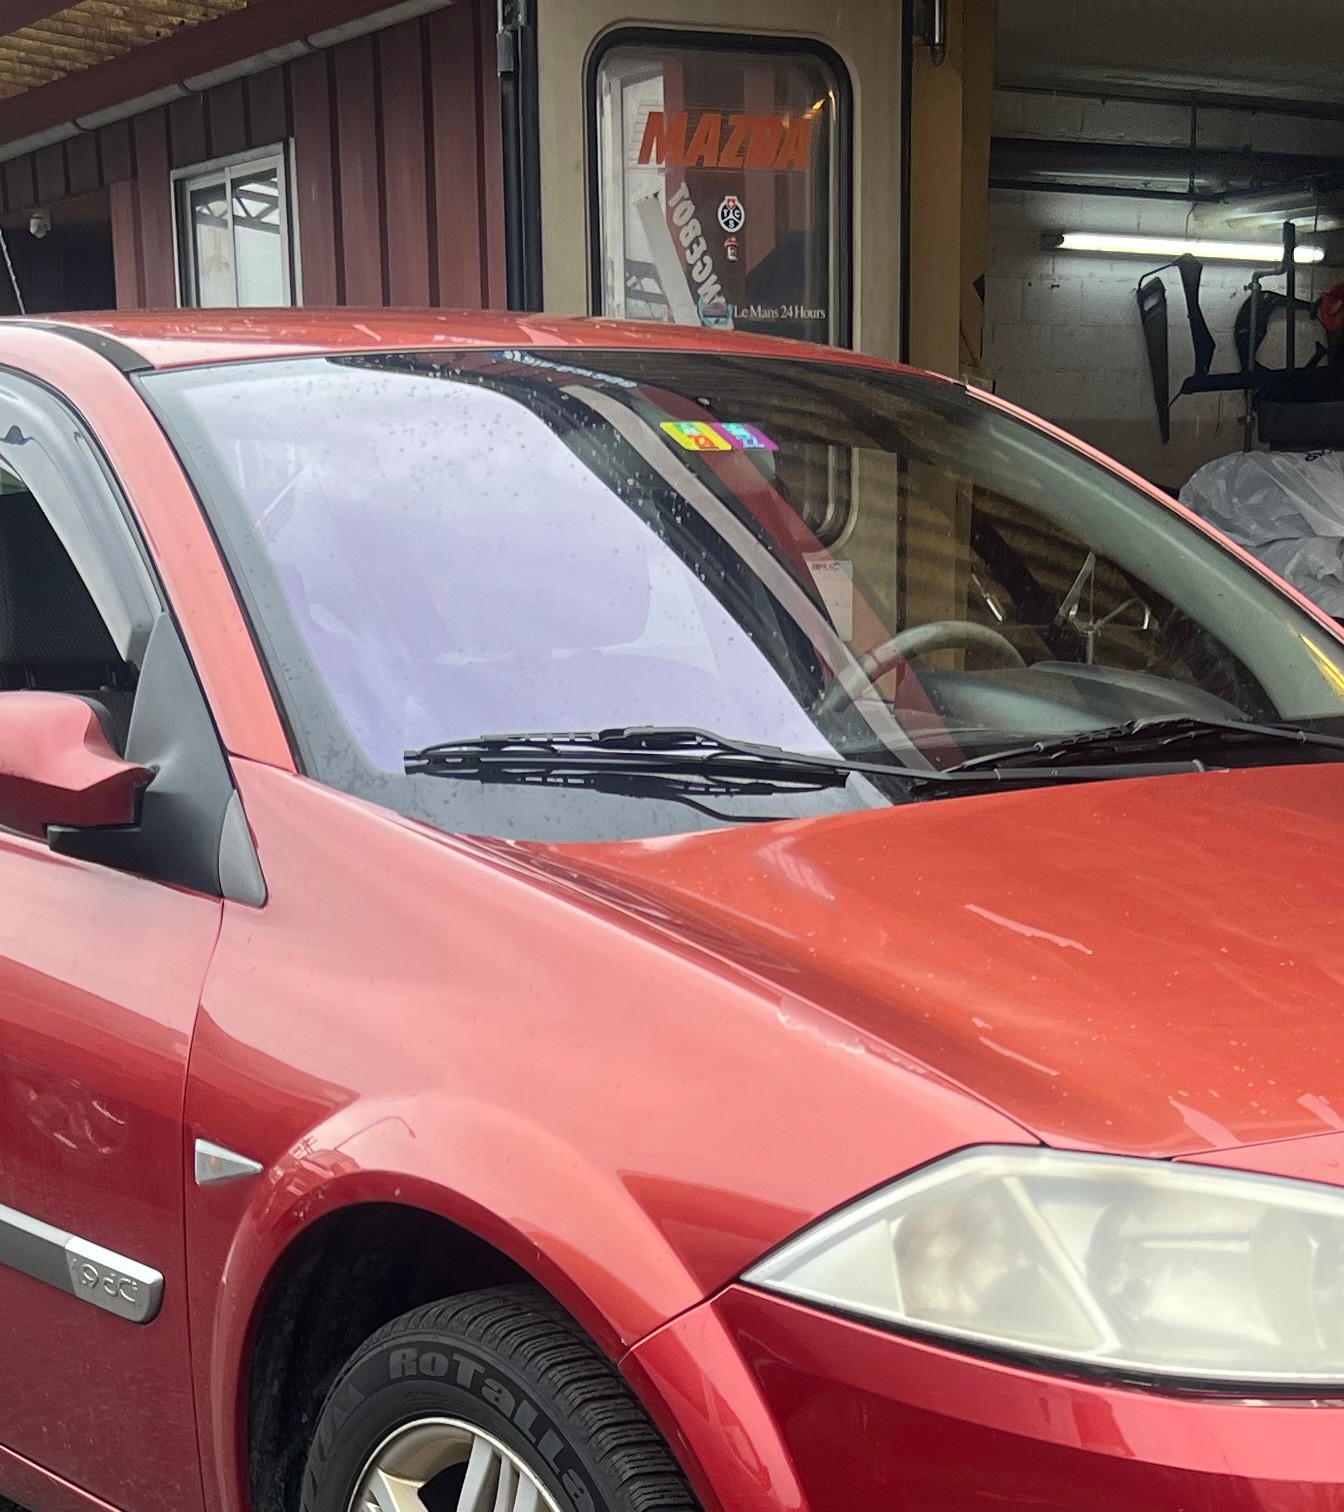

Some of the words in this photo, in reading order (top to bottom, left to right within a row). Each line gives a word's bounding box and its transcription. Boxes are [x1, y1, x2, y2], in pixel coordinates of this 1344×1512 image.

[638, 111, 812, 170] MAZDA
[734, 305, 748, 318] Le
[749, 305, 779, 319] Mans
[779, 304, 794, 319] 24
[794, 305, 826, 320] Hours
